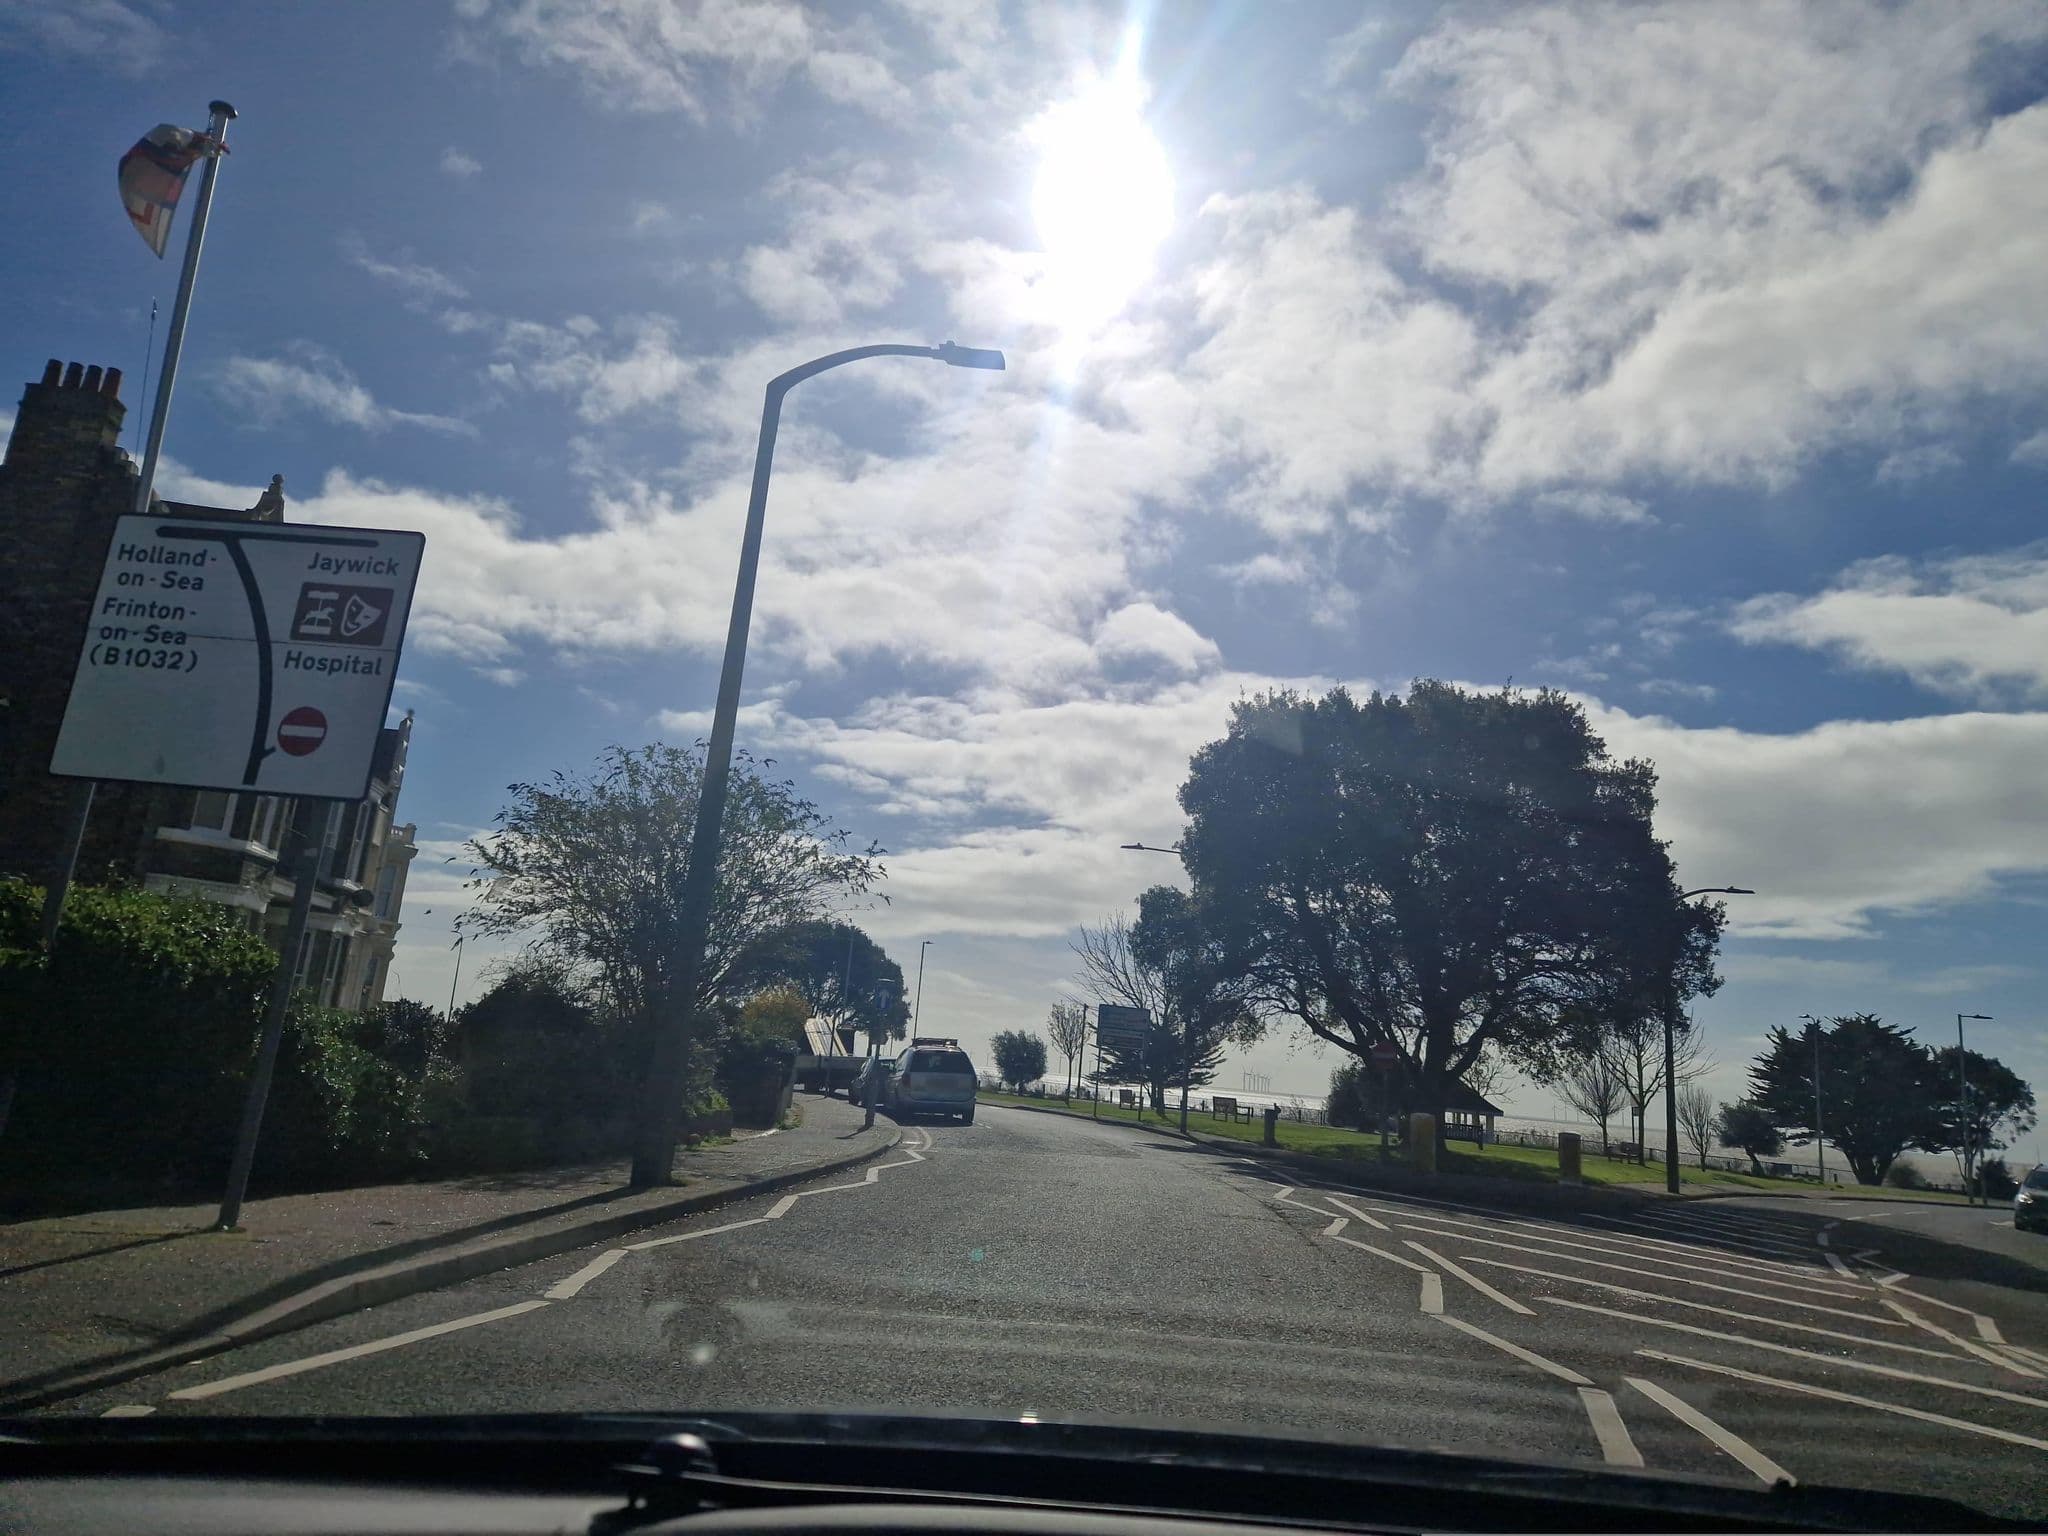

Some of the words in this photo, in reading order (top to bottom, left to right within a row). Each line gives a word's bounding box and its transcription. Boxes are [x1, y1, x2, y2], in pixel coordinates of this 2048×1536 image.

[117, 543, 218, 568] Holland-
[307, 552, 401, 577] Jaywick
[117, 571, 204, 592] on-Sea
[102, 597, 197, 621] Frinton-
[99, 624, 187, 645] on-Sea
[89, 645, 198, 673] (B1032)
[283, 650, 382, 677] Hospital
